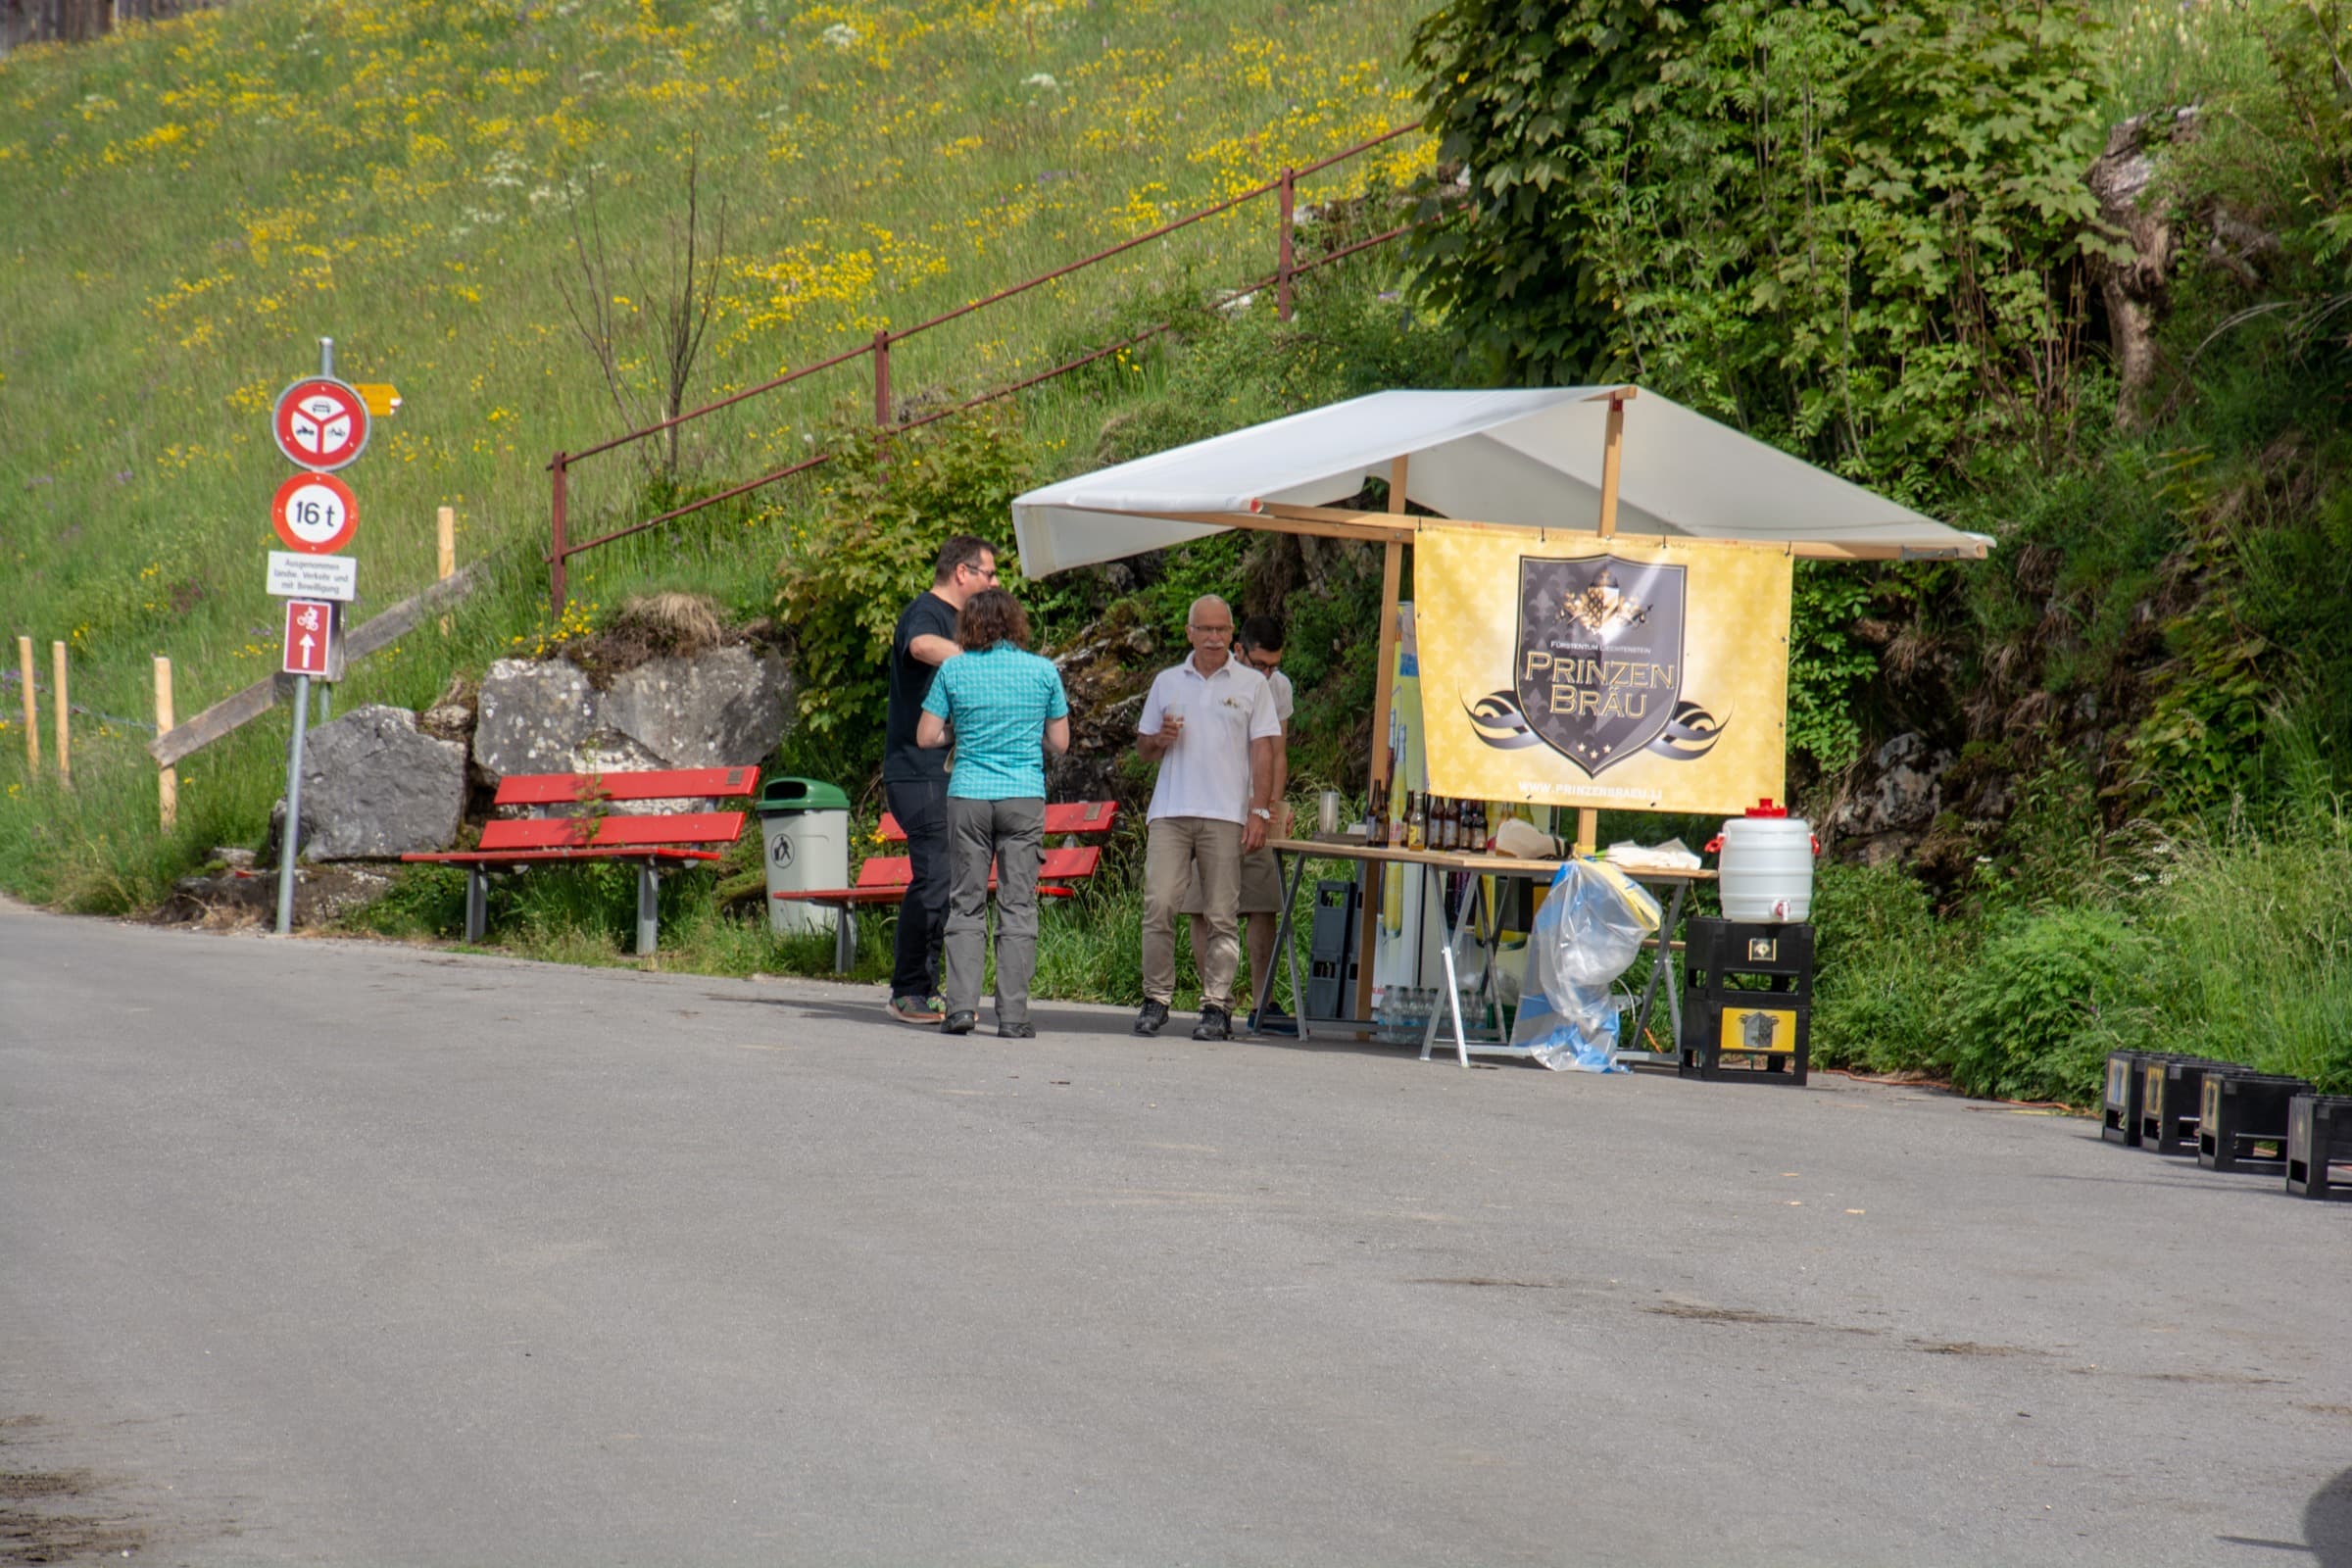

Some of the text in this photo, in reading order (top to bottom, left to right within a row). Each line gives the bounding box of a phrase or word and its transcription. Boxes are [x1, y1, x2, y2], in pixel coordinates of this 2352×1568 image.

[297, 501, 335, 527] 16 t
[284, 558, 340, 570] Ausgenommen
[303, 570, 330, 581] Verkehr
[297, 582, 340, 595] Bewilligung
[1550, 640, 1599, 652] FÜRSTENTUM
[1525, 651, 1675, 690] PRINZEN
[1549, 684, 1647, 720] BRÄU
